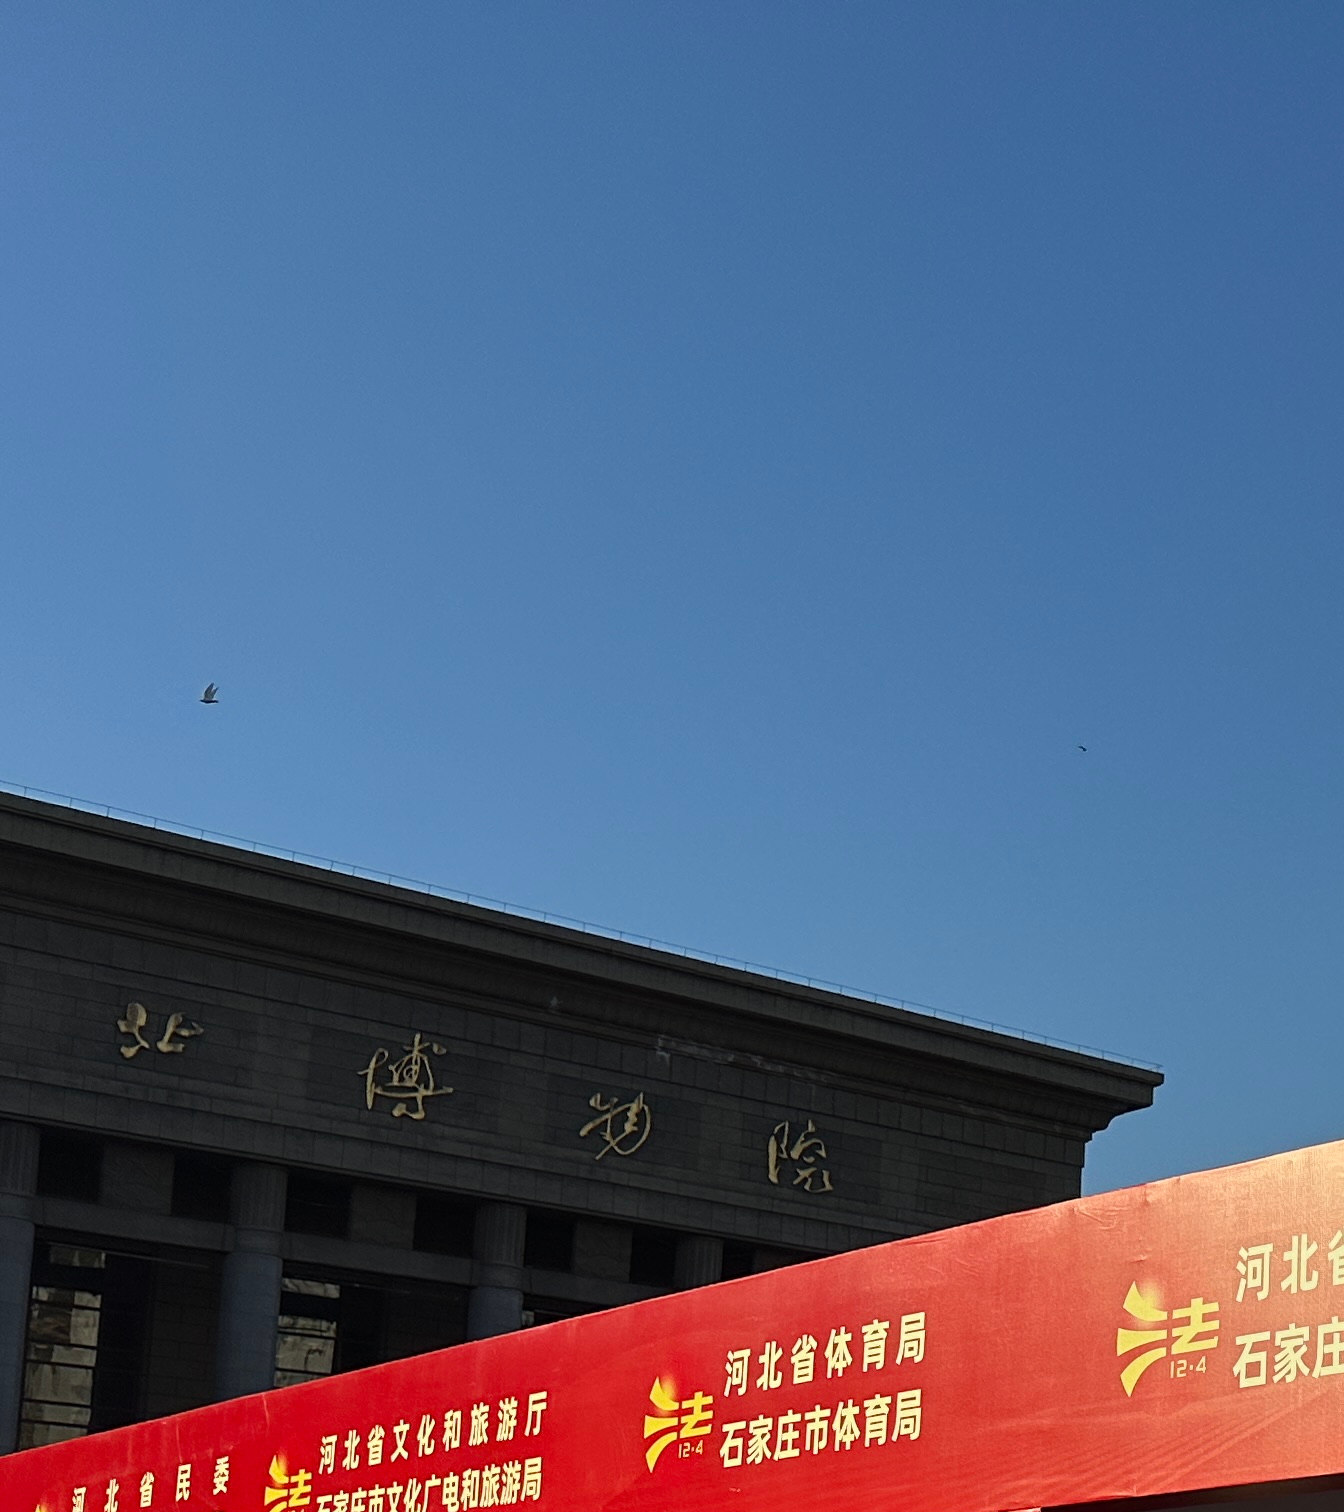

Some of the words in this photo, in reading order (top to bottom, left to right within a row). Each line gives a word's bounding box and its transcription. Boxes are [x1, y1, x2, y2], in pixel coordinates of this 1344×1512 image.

[723, 1312, 925, 1397] 河北省体育局
[318, 1391, 547, 1475] 河北省文化和旅游厅
[719, 1389, 922, 1468] 石家庄市体育局
